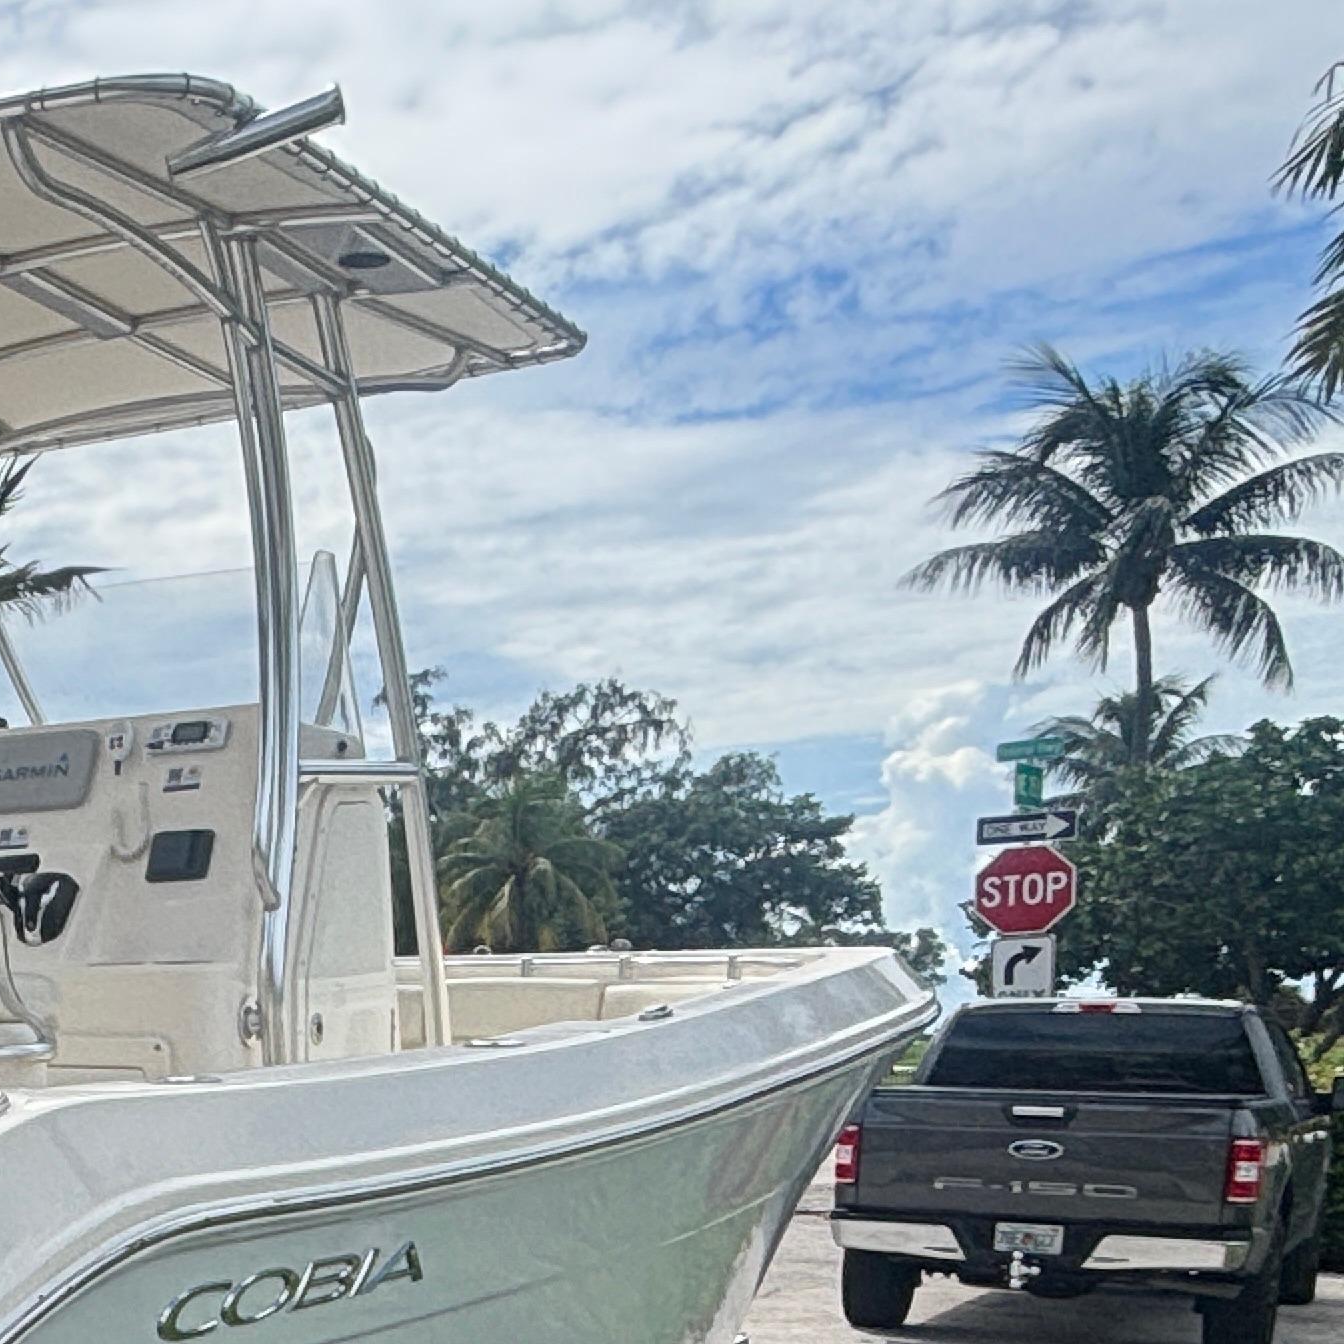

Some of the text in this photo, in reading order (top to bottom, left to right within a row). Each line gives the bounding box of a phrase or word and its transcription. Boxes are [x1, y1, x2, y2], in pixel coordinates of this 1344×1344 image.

[980, 871, 1068, 909] STOP
[933, 1176, 1138, 1199] F-150
[156, 1240, 423, 1341] COBIA
